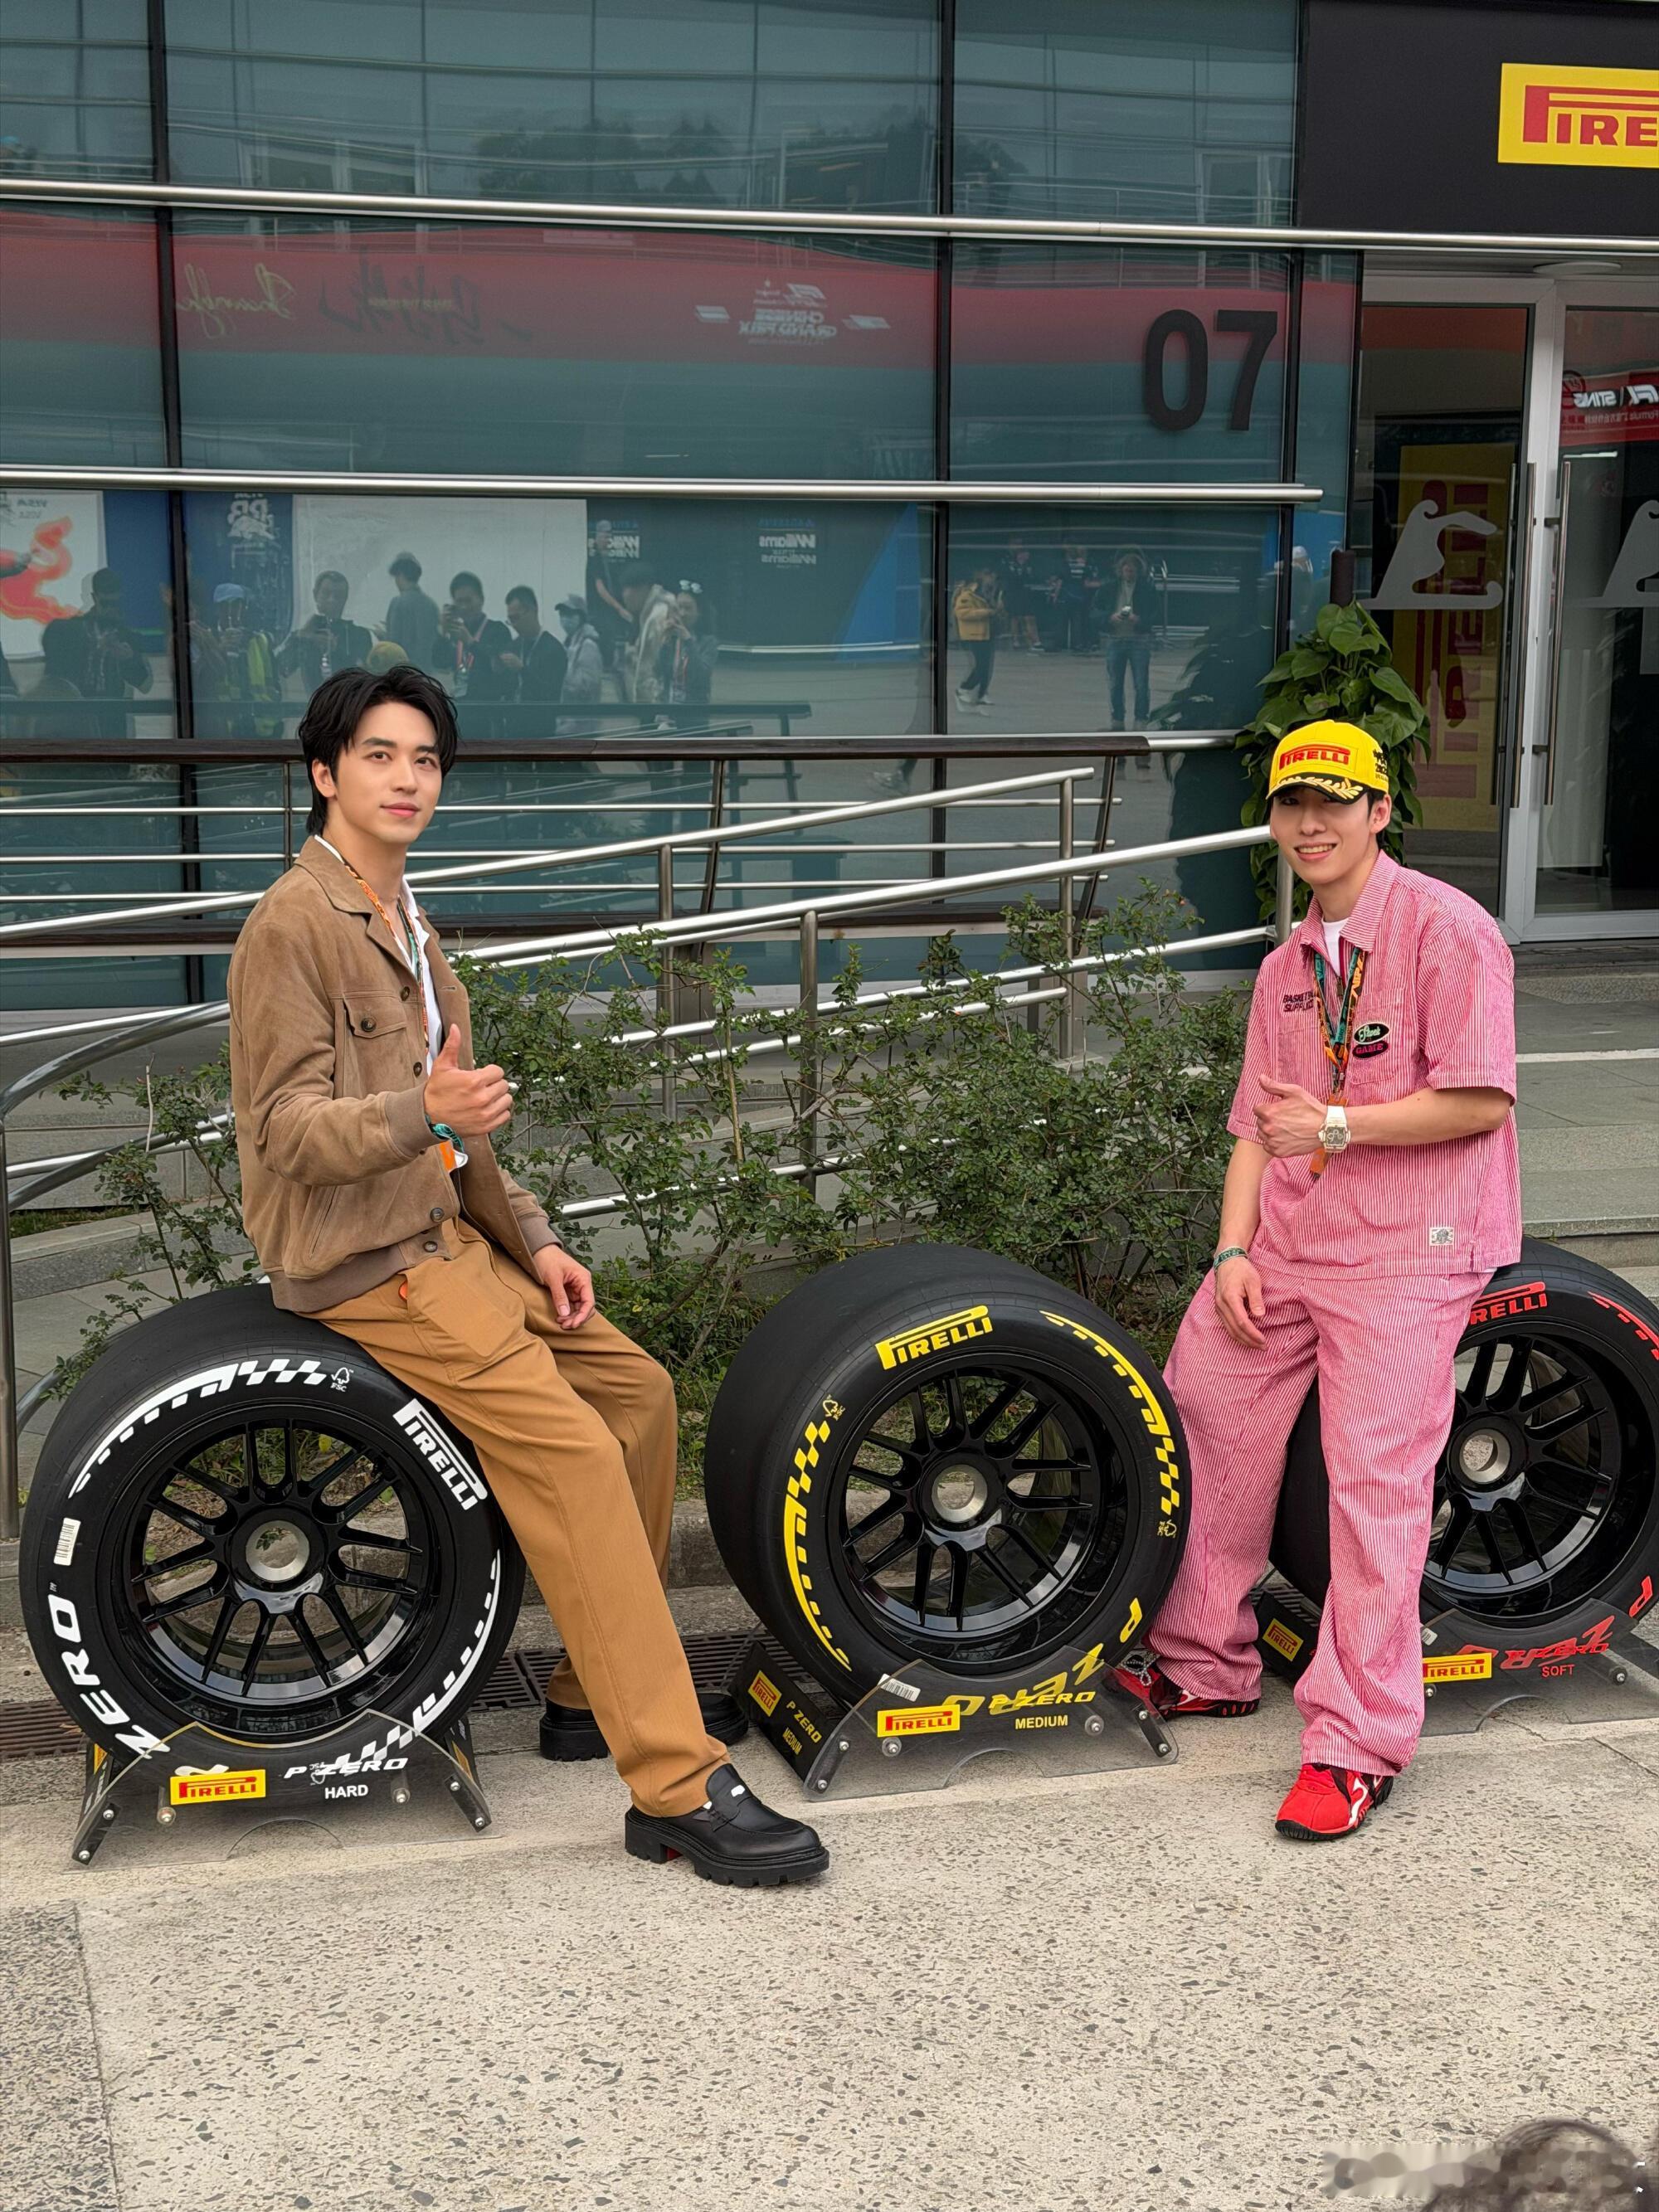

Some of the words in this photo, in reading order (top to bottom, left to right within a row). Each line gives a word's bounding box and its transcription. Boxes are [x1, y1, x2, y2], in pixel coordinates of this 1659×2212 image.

[1523, 85, 1659, 147] PIRE
[1144, 309, 1278, 432] 07
[1413, 480, 1489, 799] PIRELLI
[1279, 743, 1351, 770] PIRELLI
[1471, 1281, 1547, 1325] RELLI
[875, 1305, 994, 1370] PIRELLI
[392, 1398, 488, 1511] PIRELLI
[1267, 1623, 1298, 1655] PIRELLI
[47, 1594, 171, 1760] ZERO
[1423, 1659, 1485, 1679] PIRELLI
[1541, 1664, 1575, 1678] SOFT
[752, 1676, 778, 1710] PIRELLI
[1014, 1691, 1097, 1707] ZERO
[786, 1700, 796, 1709] P
[794, 1709, 823, 1743] ZERO
[885, 1710, 953, 1732] PIRELLI
[1014, 1714, 1068, 1730] MEDIUM
[782, 1727, 803, 1756] MEDIUM
[284, 1766, 308, 1779] P
[315, 1757, 409, 1777] ZERO
[179, 1776, 257, 1799] PIRELLI
[324, 1784, 369, 1800] HARD
